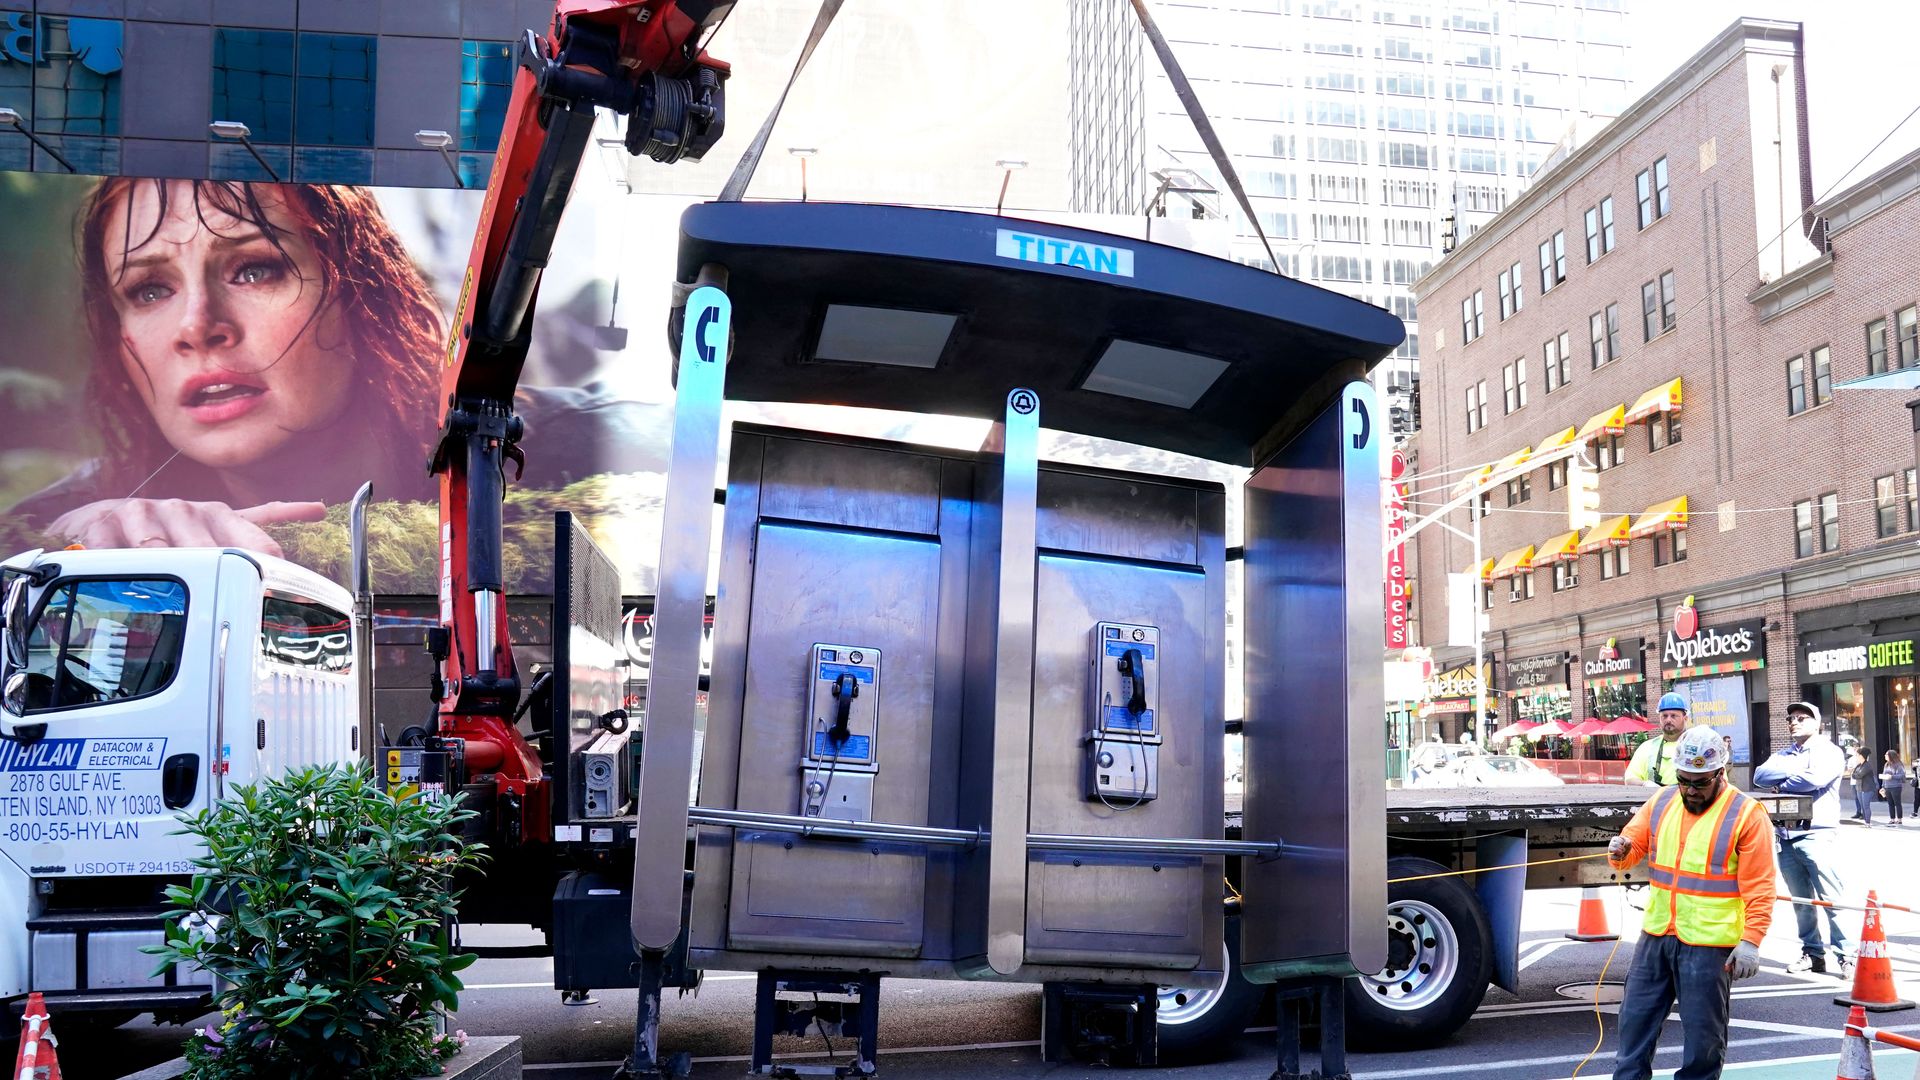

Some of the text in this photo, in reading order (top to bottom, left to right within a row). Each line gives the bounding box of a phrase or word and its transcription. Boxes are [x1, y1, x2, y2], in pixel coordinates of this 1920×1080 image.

[1012, 233, 1118, 274] TITAN
[1663, 627, 1752, 668] Applebee's
[1808, 640, 1914, 675] GREGORYS COFFEE
[1585, 658, 1630, 675] Club Room
[14, 742, 79, 767] HYLAN
[92, 742, 154, 753] DATACOM &
[88, 756, 152, 766] ELECTRICAL
[10, 772, 126, 792] 2878 GULF AVE.
[0, 795, 162, 817] TEN ISLAND, NY 10303
[74, 862, 136, 875] USDOT#
[139, 861, 197, 873] 2941534
